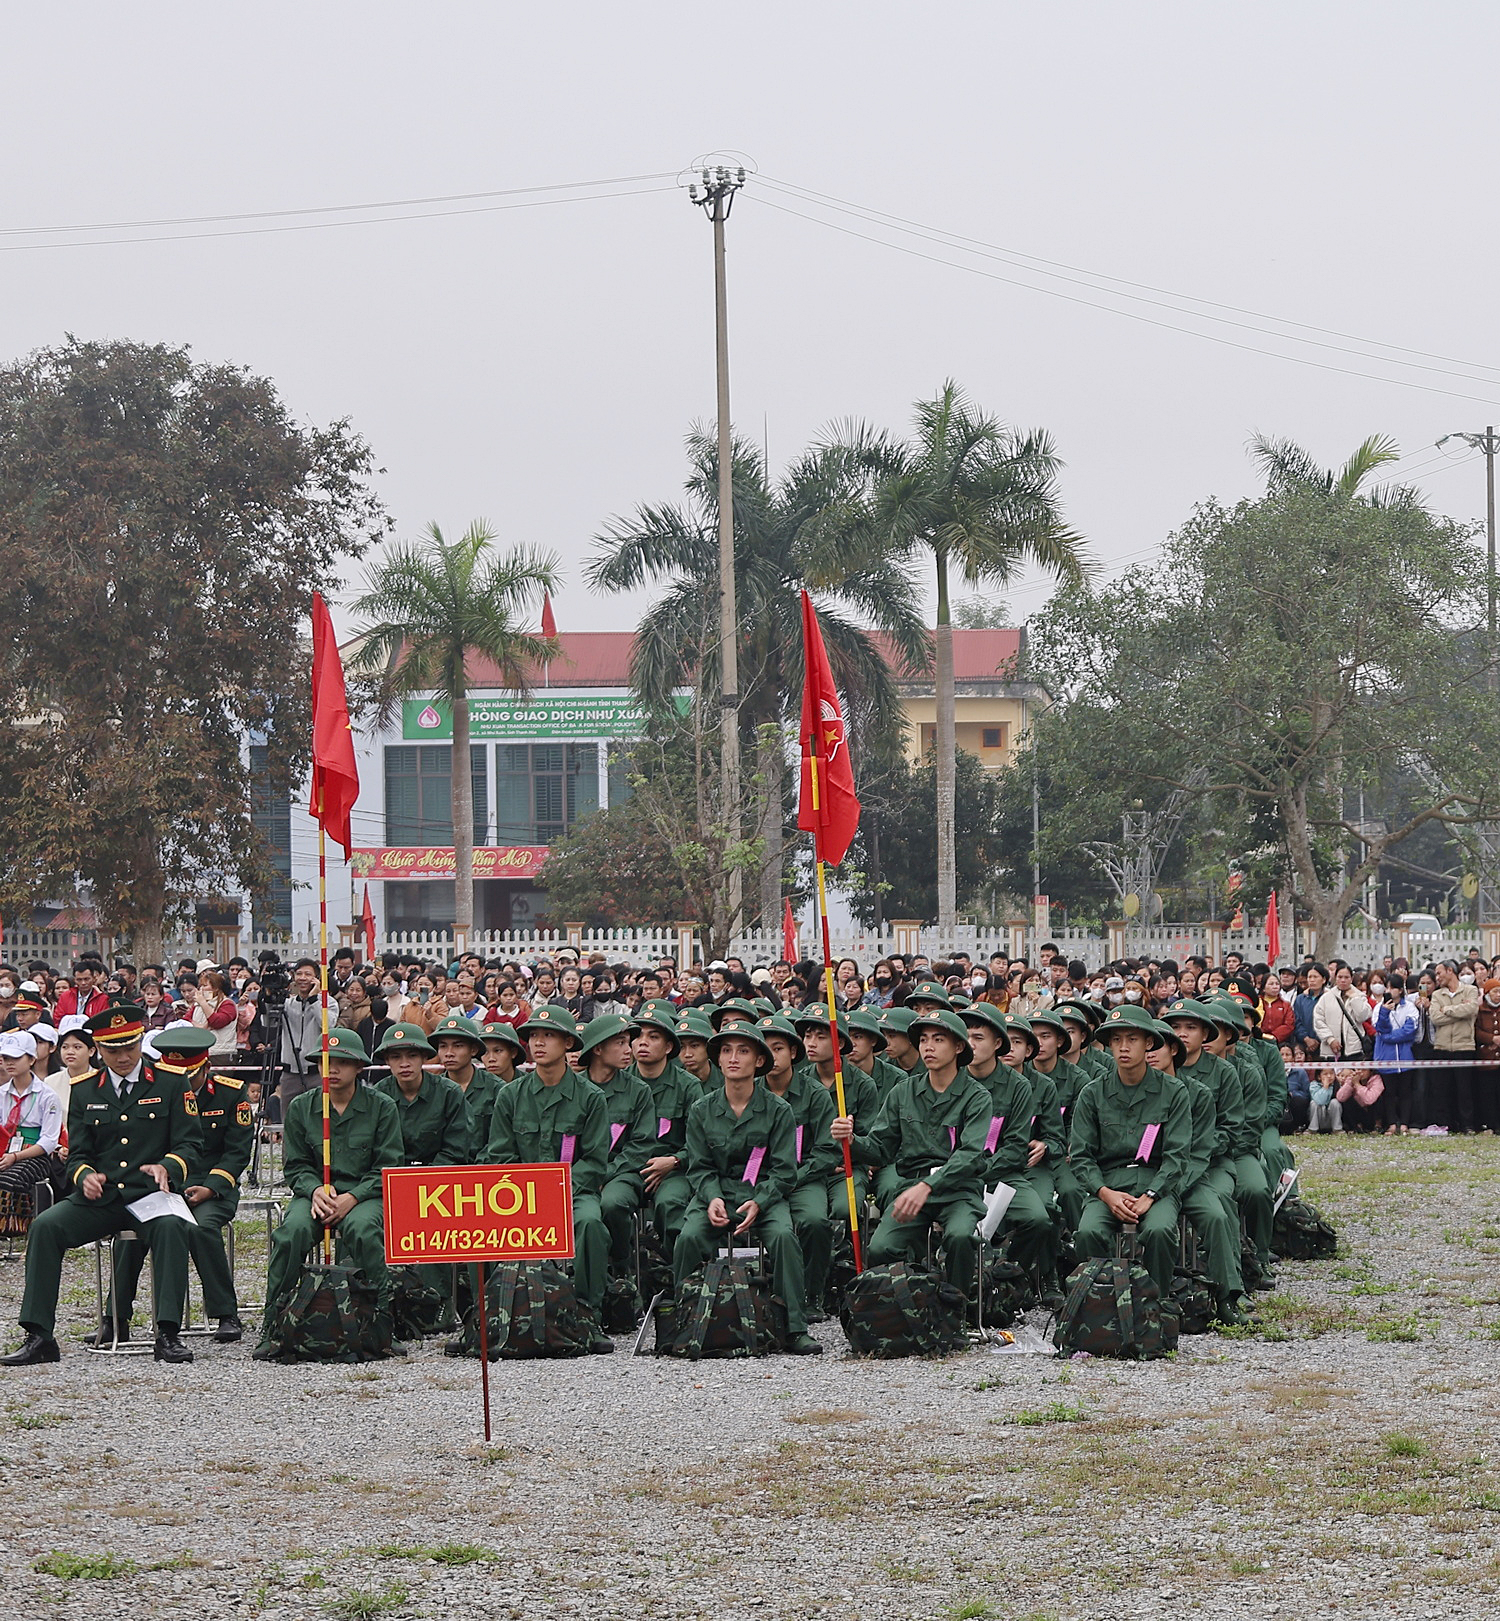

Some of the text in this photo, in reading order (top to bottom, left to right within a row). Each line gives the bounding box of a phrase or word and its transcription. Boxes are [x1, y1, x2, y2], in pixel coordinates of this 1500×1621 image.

[468, 707, 511, 722] HÒNG
[513, 711, 548, 721] GIAO
[551, 710, 585, 722] DỊCH
[586, 708, 616, 720] NHƯ
[381, 850, 417, 870] Chúc
[417, 849, 457, 870] Mừng
[498, 849, 533, 868] Mới
[472, 866, 494, 876] 026
[418, 1174, 537, 1219] KHỐI
[400, 1226, 558, 1252] d14/f324/QK4
